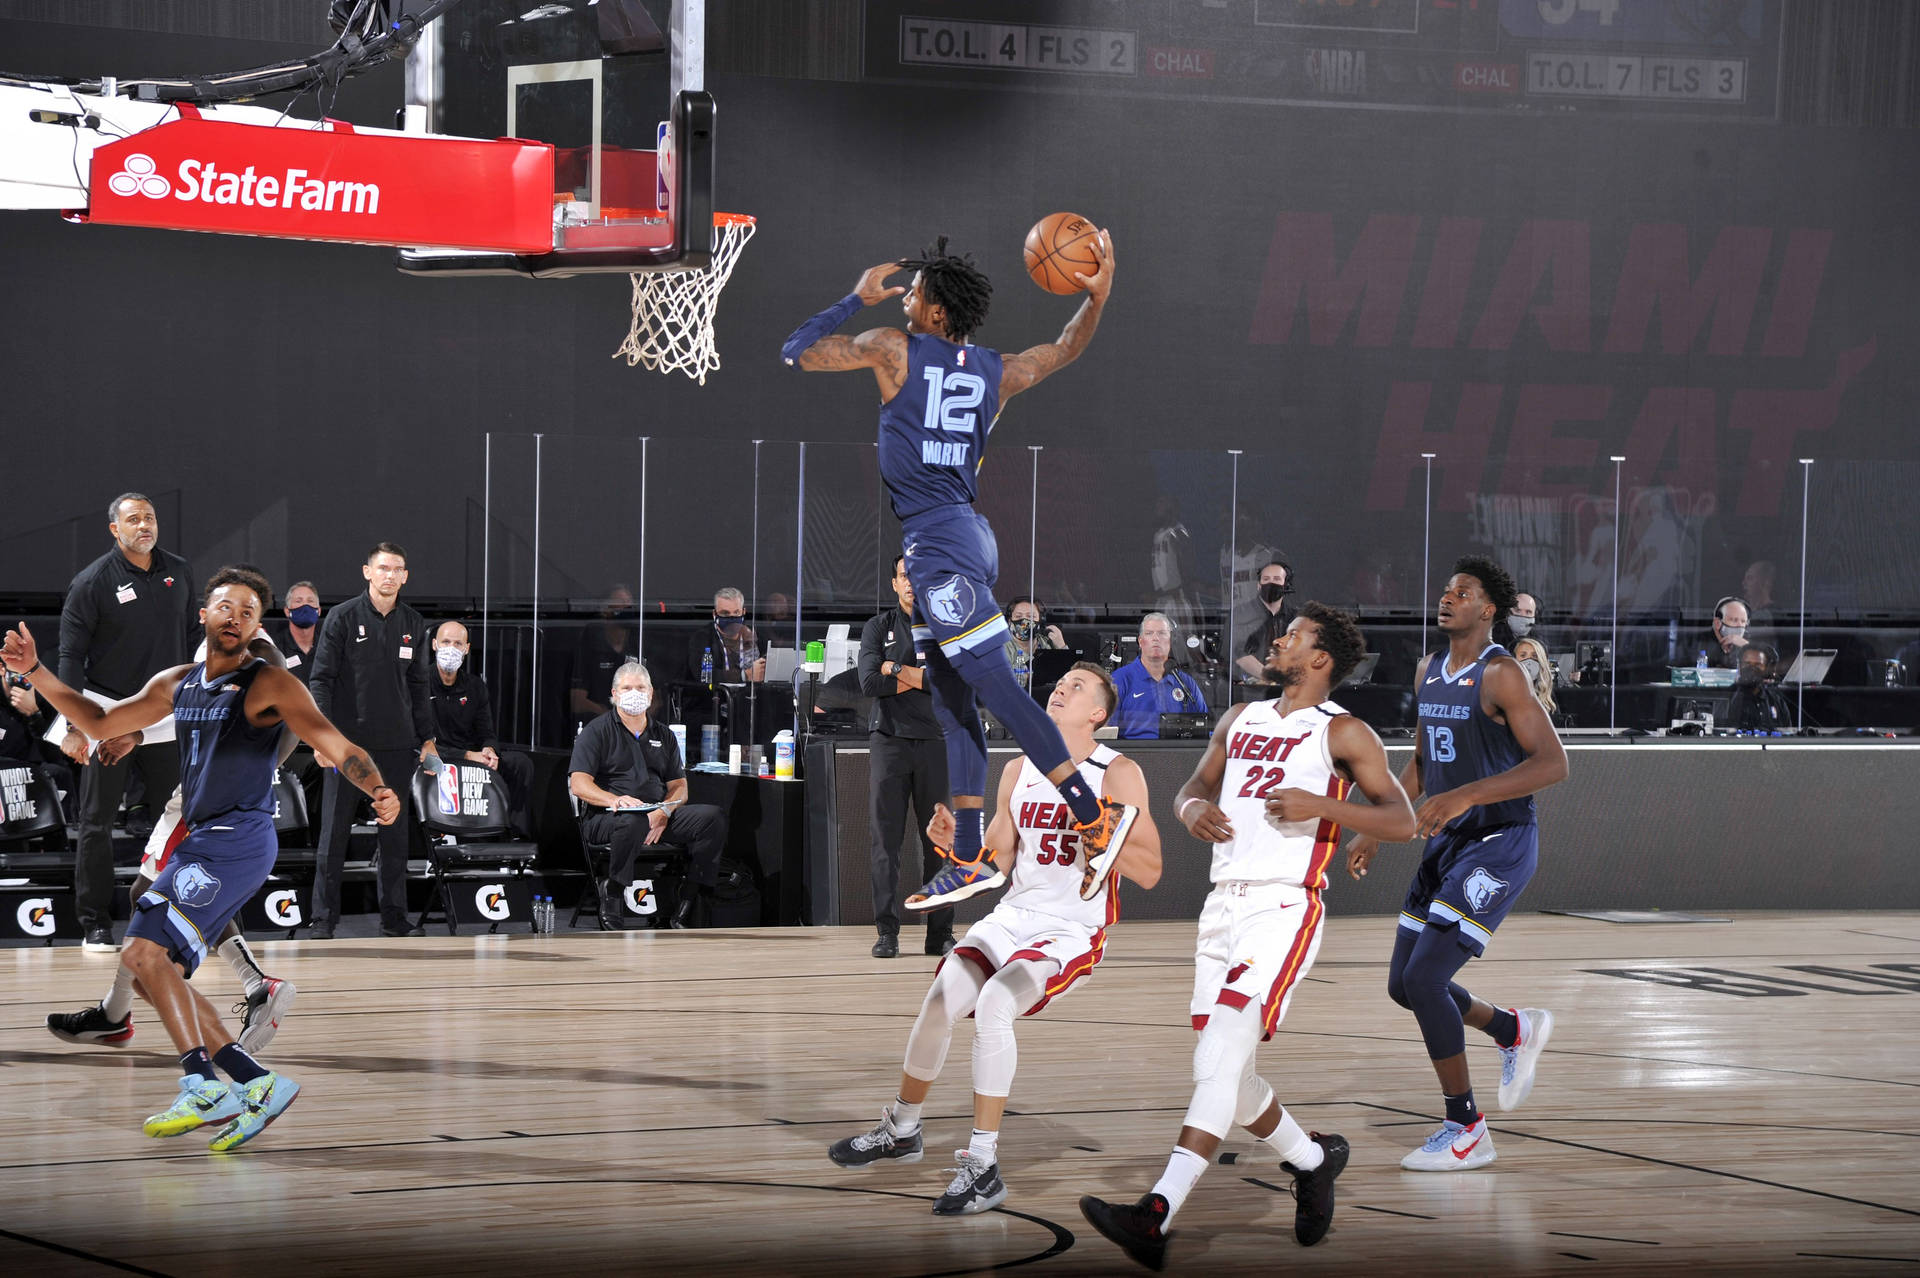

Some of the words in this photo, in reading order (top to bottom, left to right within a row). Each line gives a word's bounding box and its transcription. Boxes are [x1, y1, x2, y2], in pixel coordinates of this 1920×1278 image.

[999, 32, 1016, 62] 4
[1038, 35, 1089, 66] FLS
[1109, 39, 1127, 68] 2
[1153, 52, 1206, 73] CHAL
[1461, 66, 1511, 88] CHAL
[1616, 63, 1633, 91] 7
[1653, 64, 1700, 93] FLS
[1718, 66, 1734, 94] 3
[1248, 211, 1835, 358] MIAMI
[923, 365, 986, 433] 12
[1365, 333, 1878, 517] HEAT
[1418, 702, 1471, 720] GRIZZLIES
[190, 729, 201, 766] 1
[1226, 730, 1312, 763] HEAT
[1426, 725, 1457, 763] 13
[0, 766, 35, 787] WHOLE
[461, 765, 492, 784] WHOLE
[462, 782, 484, 799] NEW
[1236, 765, 1286, 800] 22
[4, 784, 27, 805] NEW
[8, 800, 38, 822] GAME
[463, 798, 489, 816] GAME
[1019, 801, 1078, 831] HEA
[1036, 833, 1080, 867] 55
[264, 889, 302, 927] G
[475, 883, 511, 921] G
[624, 879, 658, 915] G
[16, 897, 56, 937] G
